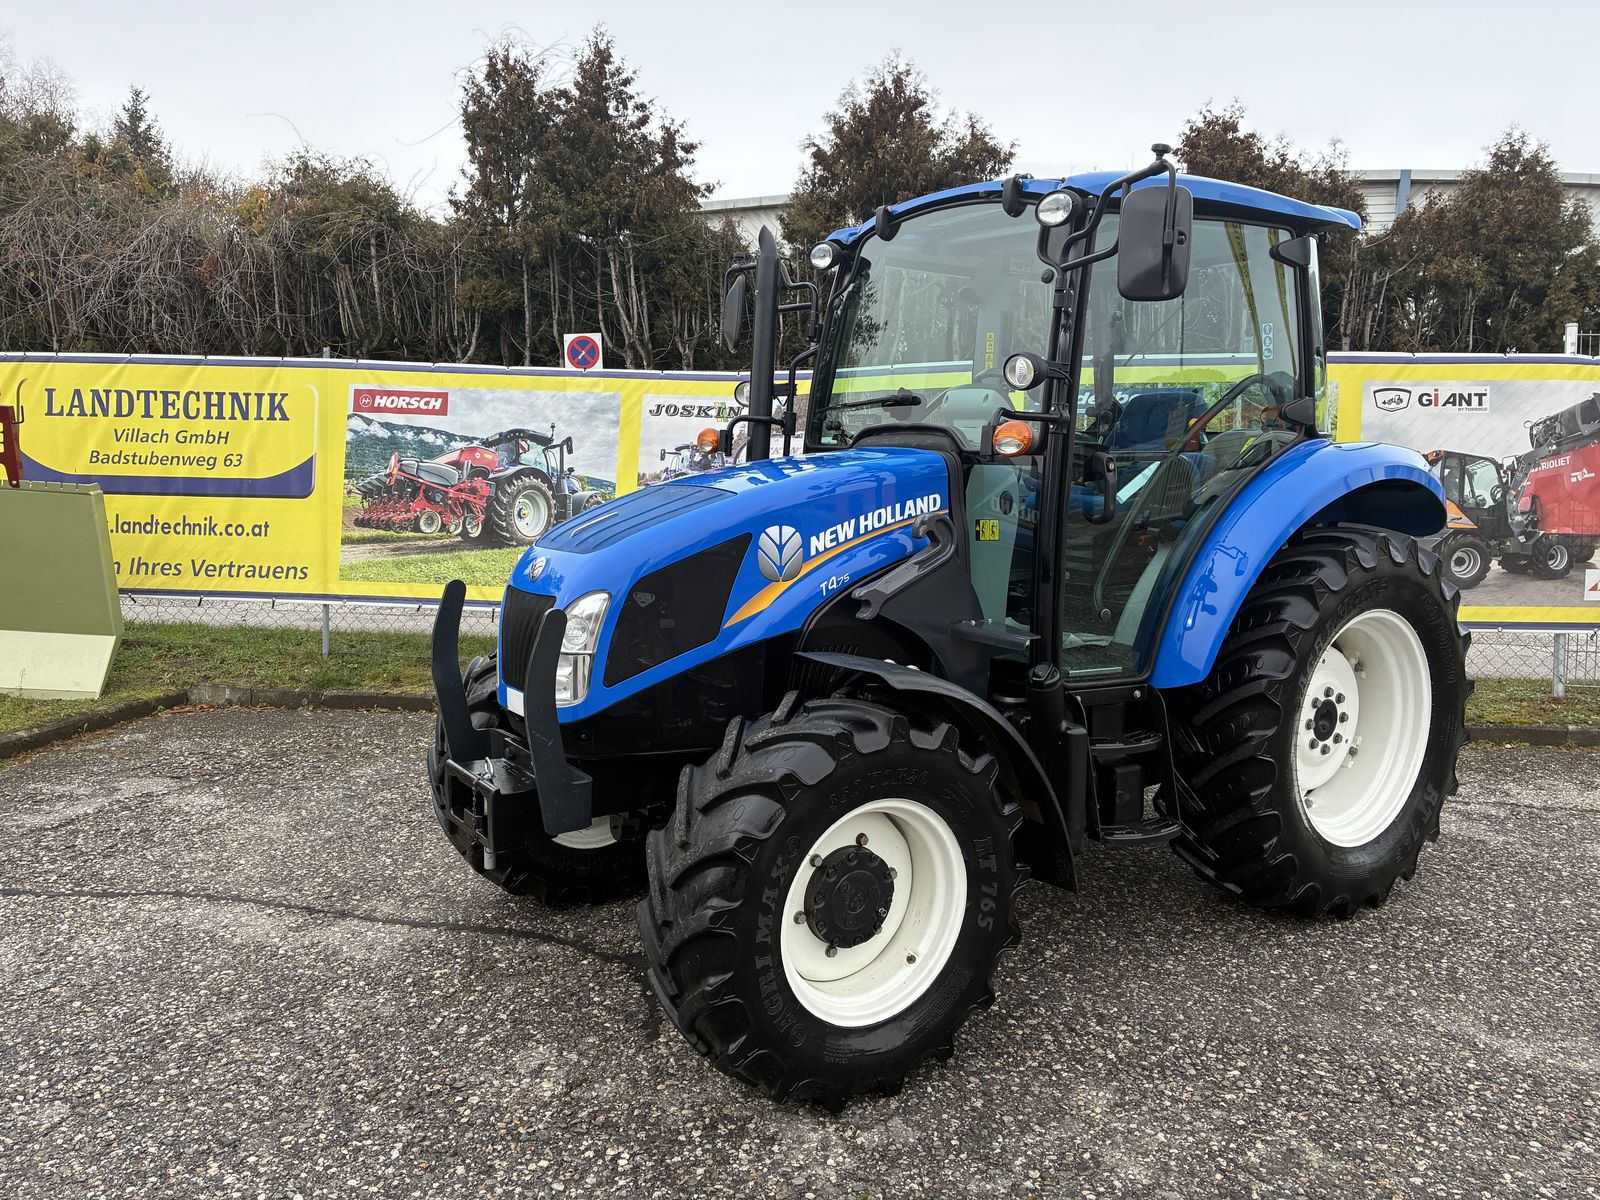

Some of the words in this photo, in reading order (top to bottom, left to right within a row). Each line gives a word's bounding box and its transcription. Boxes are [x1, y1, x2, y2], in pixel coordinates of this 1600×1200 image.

[44, 388, 290, 421] LANDTECHNIK
[373, 395, 443, 410] HORSCH
[648, 403, 744, 418] JOSKIN
[113, 428, 169, 444] Villach
[175, 431, 230, 445] GmbH
[89, 450, 217, 470] Badstubenweg
[223, 453, 243, 467] 63
[106, 513, 270, 537] .landtechnik.co.at
[810, 519, 856, 556] NEW
[859, 493, 942, 535] HOLLAND
[128, 556, 183, 577] Ihres
[190, 559, 309, 580] Vertrauens
[977, 882, 999, 932] 765
